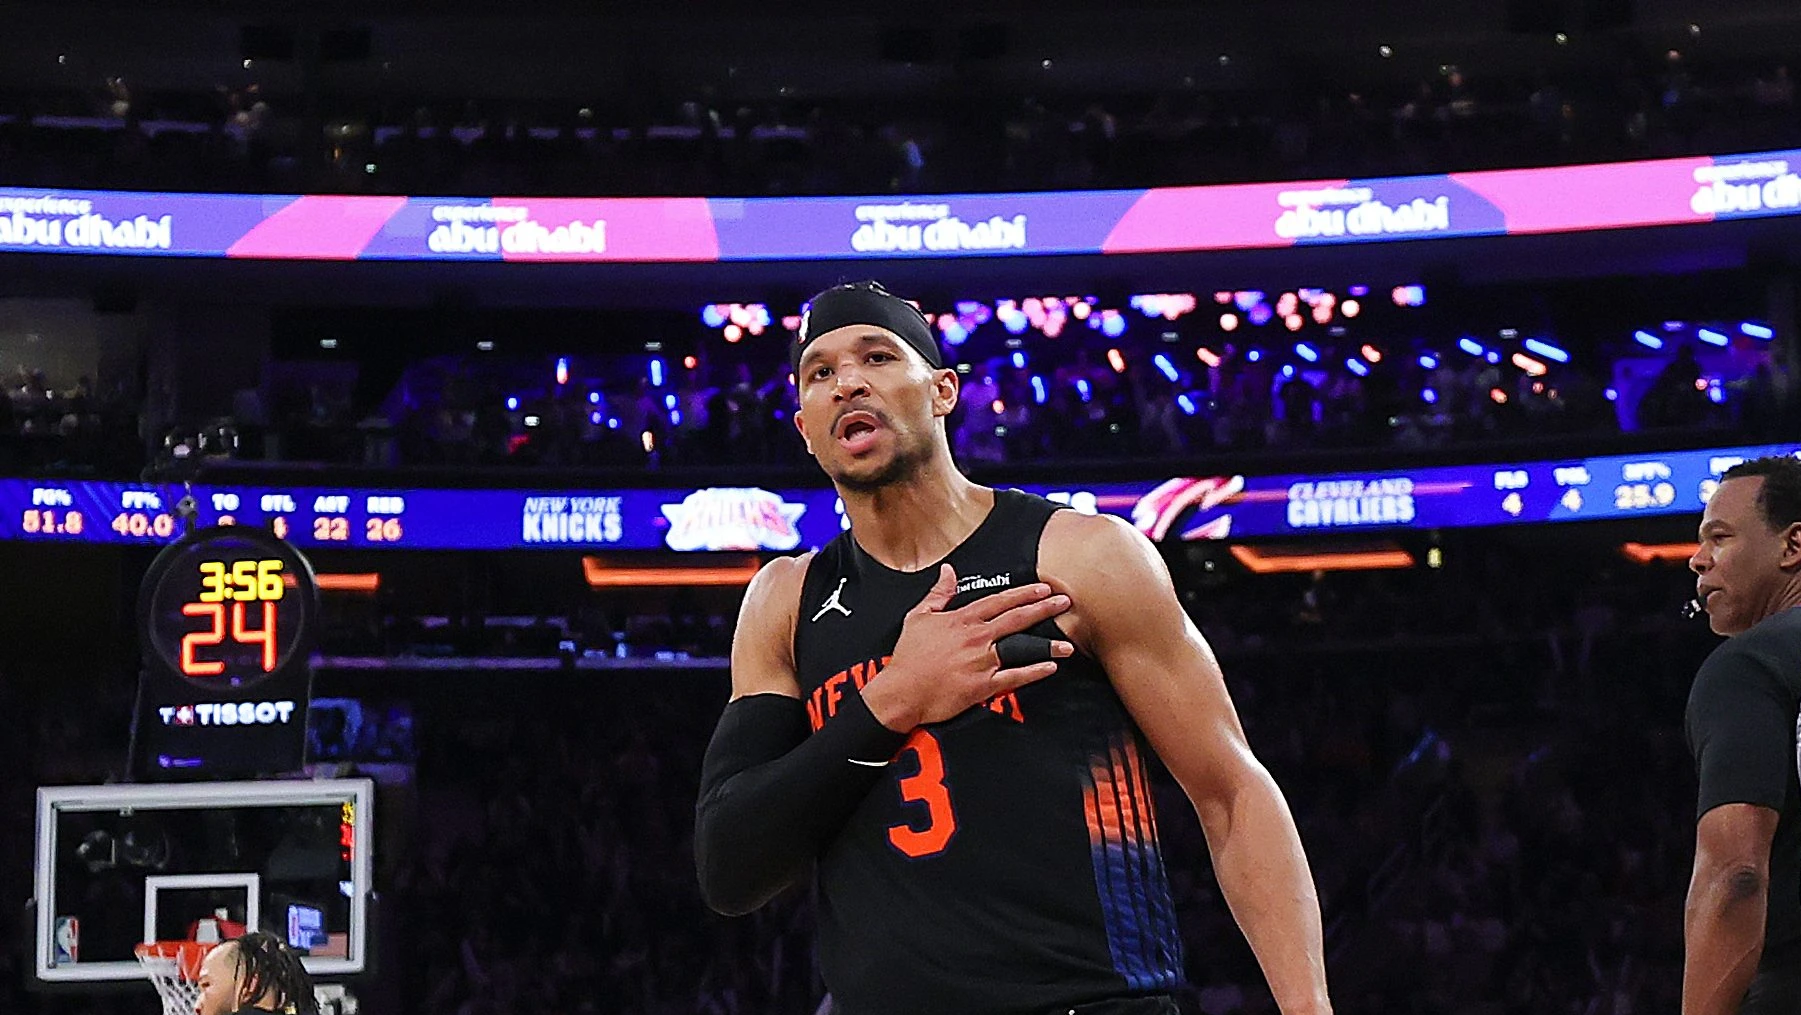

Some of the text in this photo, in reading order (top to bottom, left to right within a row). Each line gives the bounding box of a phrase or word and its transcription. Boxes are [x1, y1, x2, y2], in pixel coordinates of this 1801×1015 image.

[1690, 181, 1761, 214] abu
[64, 214, 172, 249] dhabi
[851, 215, 1027, 251] abu dhabi
[1275, 195, 1449, 238] abu dhabi
[428, 219, 606, 253] abu dhabi
[212, 493, 239, 511] TO
[524, 497, 622, 513] NEW YORK
[1288, 478, 1414, 500] CLEVELAND
[112, 513, 173, 536] 40.0
[314, 517, 349, 540] 22
[367, 518, 403, 541] 26
[523, 512, 622, 542] KNICKS
[199, 560, 284, 602] 3:56
[180, 602, 277, 675] 24
[888, 727, 957, 858] 3
